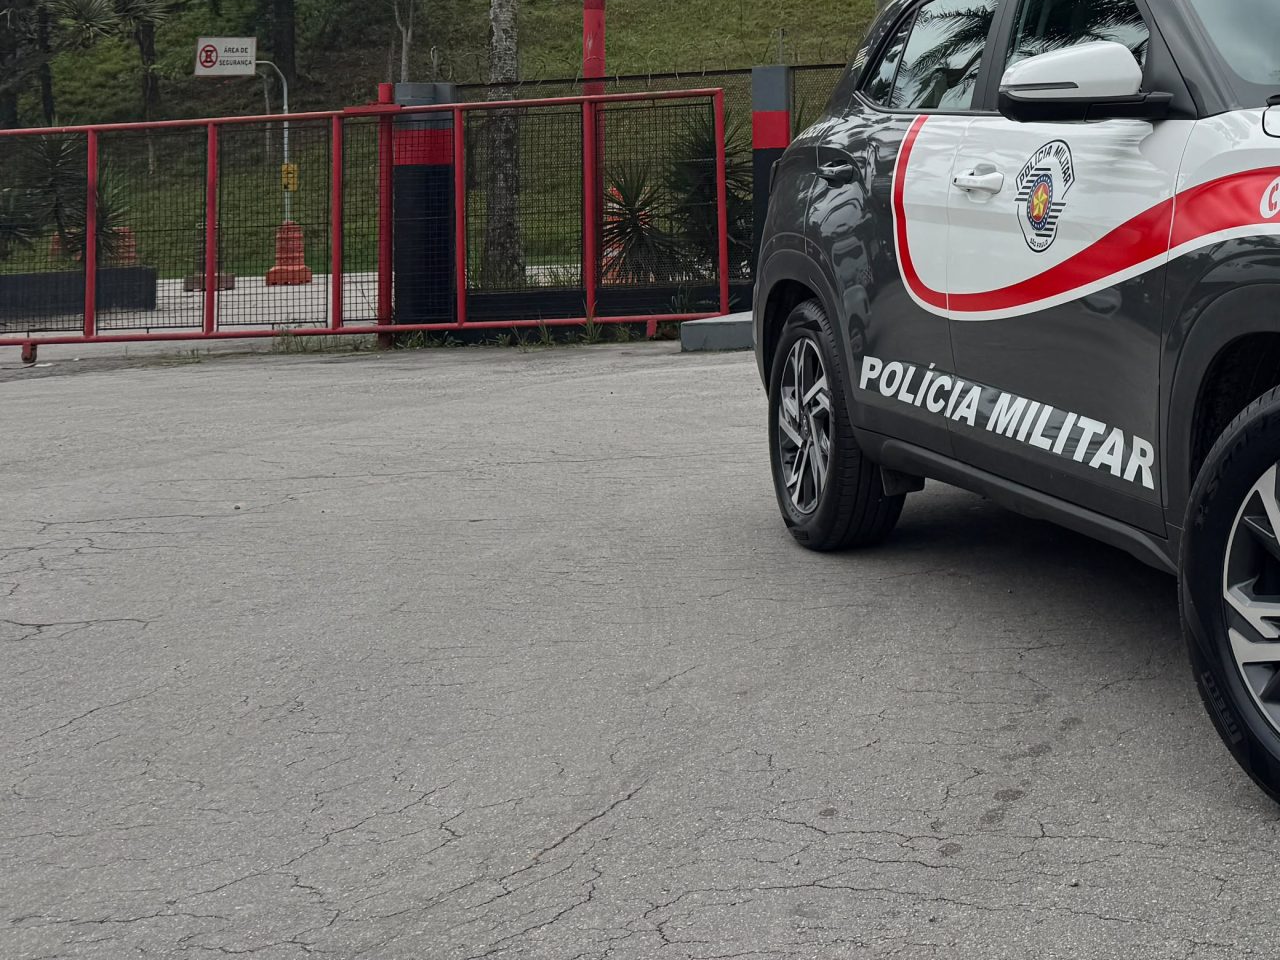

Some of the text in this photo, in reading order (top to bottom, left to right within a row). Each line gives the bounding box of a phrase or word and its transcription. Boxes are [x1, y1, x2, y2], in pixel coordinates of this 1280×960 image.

[219, 59, 252, 67] SEGURANÇA
[1053, 144, 1071, 187] MILITAR
[859, 355, 982, 426] POLÍCIA
[985, 392, 1155, 490] MILITAR
